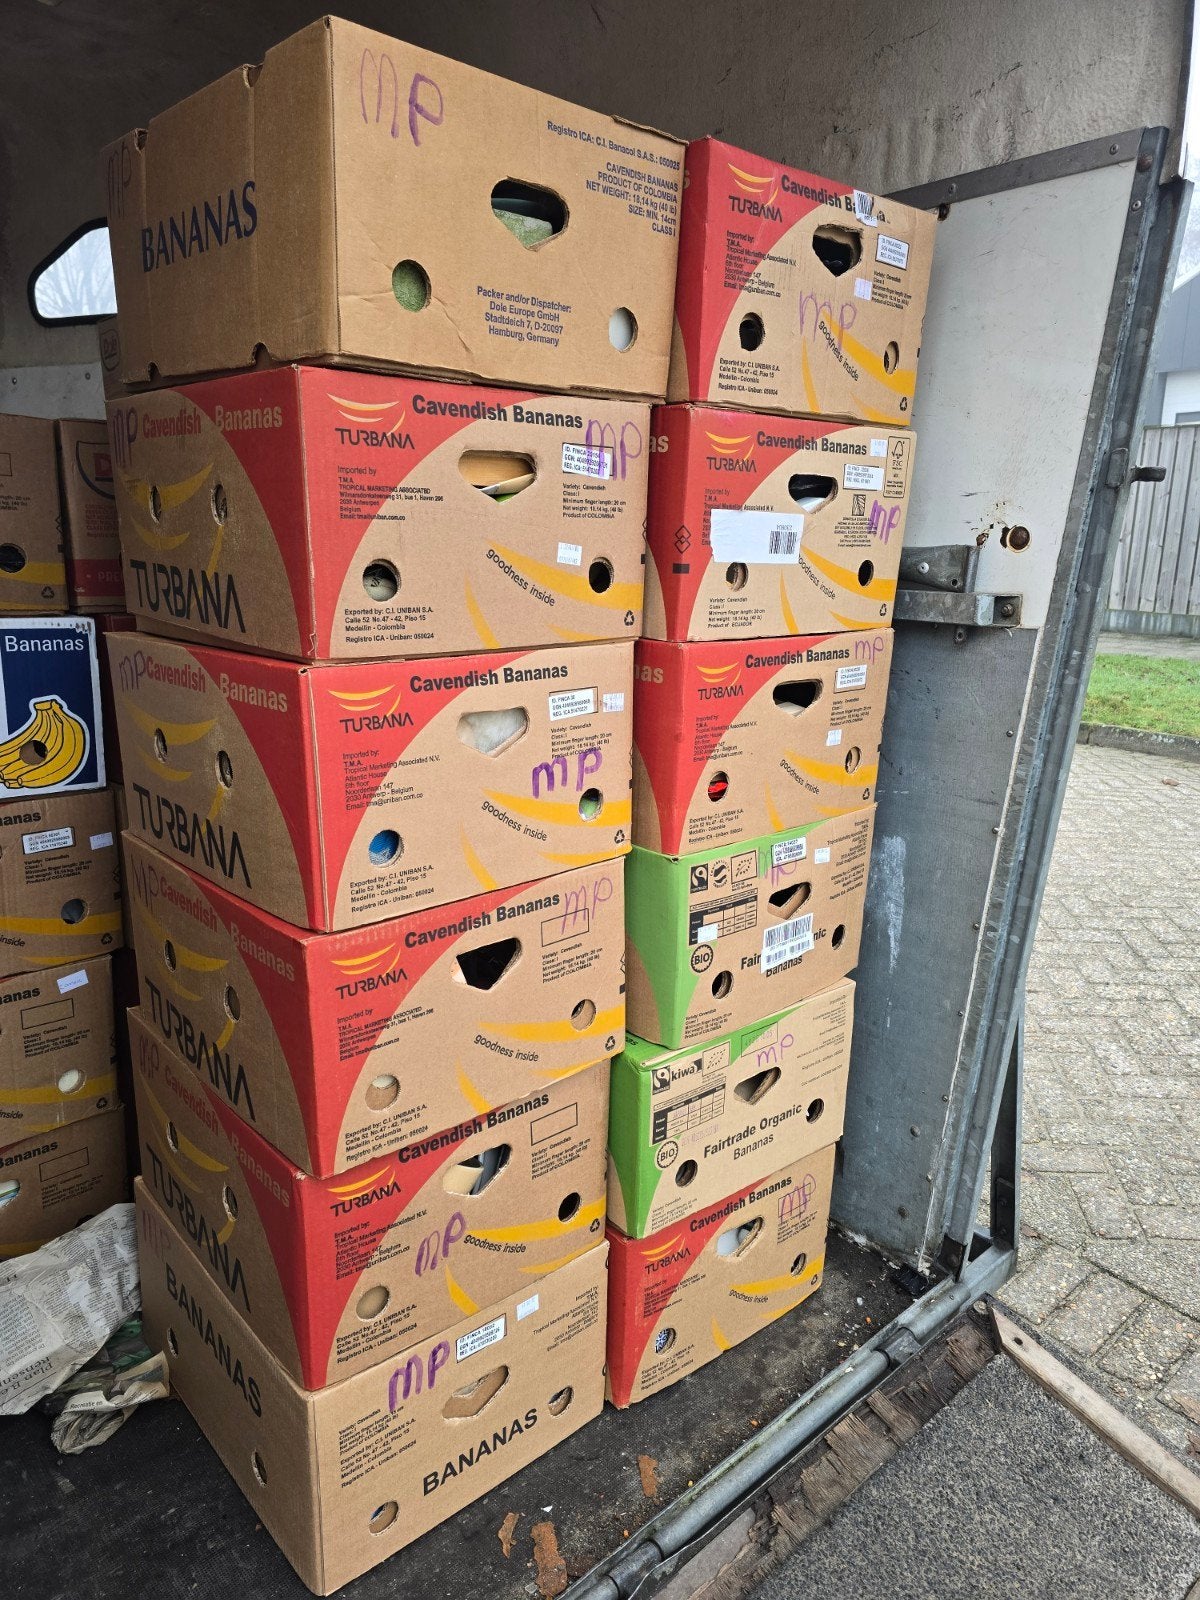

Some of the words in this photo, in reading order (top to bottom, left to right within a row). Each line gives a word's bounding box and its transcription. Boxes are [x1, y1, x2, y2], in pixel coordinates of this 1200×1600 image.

[547, 120, 578, 138] Registro
[579, 130, 595, 145] ICA:
[595, 136, 607, 148] C.I.
[608, 140, 636, 157] Banacol
[636, 149, 658, 164] S.A.S.:
[598, 171, 632, 190] PRODUCT
[633, 182, 643, 192] OF
[644, 185, 677, 203] COLOMBIA
[606, 162, 646, 181] CAVENDISH
[647, 176, 678, 192] BANANAS
[781, 174, 842, 208] Cavendish
[586, 180, 600, 192] NET
[602, 184, 631, 200] WEIGHT:
[650, 199, 658, 210] kg
[669, 205, 677, 215] lb)
[729, 196, 783, 223] TURBANA
[141, 180, 258, 274] BANANAS
[628, 204, 645, 216] SIZE:
[646, 209, 659, 221] MIN.
[660, 213, 677, 225] 14cm
[652, 223, 672, 235] CLASS
[673, 228, 676, 236] I
[477, 286, 503, 299] Packer
[506, 293, 530, 305] and/or
[531, 297, 572, 313] Dispatcher:
[490, 301, 507, 312] Dole
[509, 305, 535, 318] Europe
[537, 311, 560, 322] GmbH
[485, 312, 524, 328] Stadtdeich
[534, 322, 563, 334] D-20097
[489, 325, 524, 341] Hamburg,
[527, 332, 559, 347] Germany
[818, 321, 844, 363] goodness
[843, 358, 859, 381] inside
[143, 407, 201, 438] Cavendish
[214, 406, 282, 433] Bananas
[412, 394, 508, 422] Cavendish
[513, 407, 583, 428] Bananas
[335, 427, 415, 450] TURBANA
[756, 431, 818, 452] Cavendish
[821, 438, 867, 456] Bananas
[338, 466, 366, 475] Imported
[369, 466, 376, 476] by
[706, 456, 757, 473] TURBANA
[486, 548, 528, 590] goodness
[530, 584, 556, 607] inside
[799, 556, 820, 588] oodness
[819, 581, 836, 600] inside
[131, 560, 246, 634] TURBANA
[5, 635, 84, 652] Bananas
[746, 651, 803, 669] Cavendish
[807, 647, 850, 662] Bananas
[146, 656, 206, 694] Cavendish
[218, 673, 288, 713] Bananas
[410, 670, 498, 693] Cavendish
[503, 663, 569, 684] Bananas
[698, 685, 744, 701] TURBANA
[340, 712, 413, 734] TURBANA
[398, 756, 428, 766] Associated
[779, 758, 804, 785] goodness
[803, 781, 820, 795] inside
[132, 783, 252, 889] TURBANA
[481, 799, 522, 832] goodness
[523, 824, 547, 842] inside
[160, 876, 218, 933] Cavendish
[230, 921, 295, 983] Bananas
[404, 912, 491, 949] Cavendish
[496, 894, 561, 921] Bananas
[694, 951, 710, 964] BIO
[335, 968, 408, 1000] TURBANA
[145, 976, 256, 1123] TURBANA
[474, 1034, 513, 1058] goodness
[514, 1050, 539, 1062] inside
[671, 1066, 695, 1081] kiwa
[165, 1068, 219, 1137] Cavendish
[231, 1131, 290, 1208] Bananas
[398, 1120, 483, 1164] Cavendish
[487, 1093, 550, 1128] Bananas
[704, 1126, 756, 1159] Fairtrade
[760, 1103, 802, 1130] Organic
[660, 1149, 675, 1161] BIO
[733, 1134, 774, 1160] Bananas
[330, 1181, 401, 1217] TURBANA
[690, 1198, 746, 1232] Cavendish
[749, 1176, 792, 1203] Bananas
[146, 1143, 251, 1314] TURBANA
[464, 1234, 503, 1253] goodness
[503, 1241, 527, 1253] inside
[645, 1248, 691, 1274] TURBANA
[729, 1289, 754, 1304] goodness
[754, 1295, 769, 1304] inside
[165, 1262, 262, 1418] BANANAS
[423, 1408, 538, 1496] BANANAS
